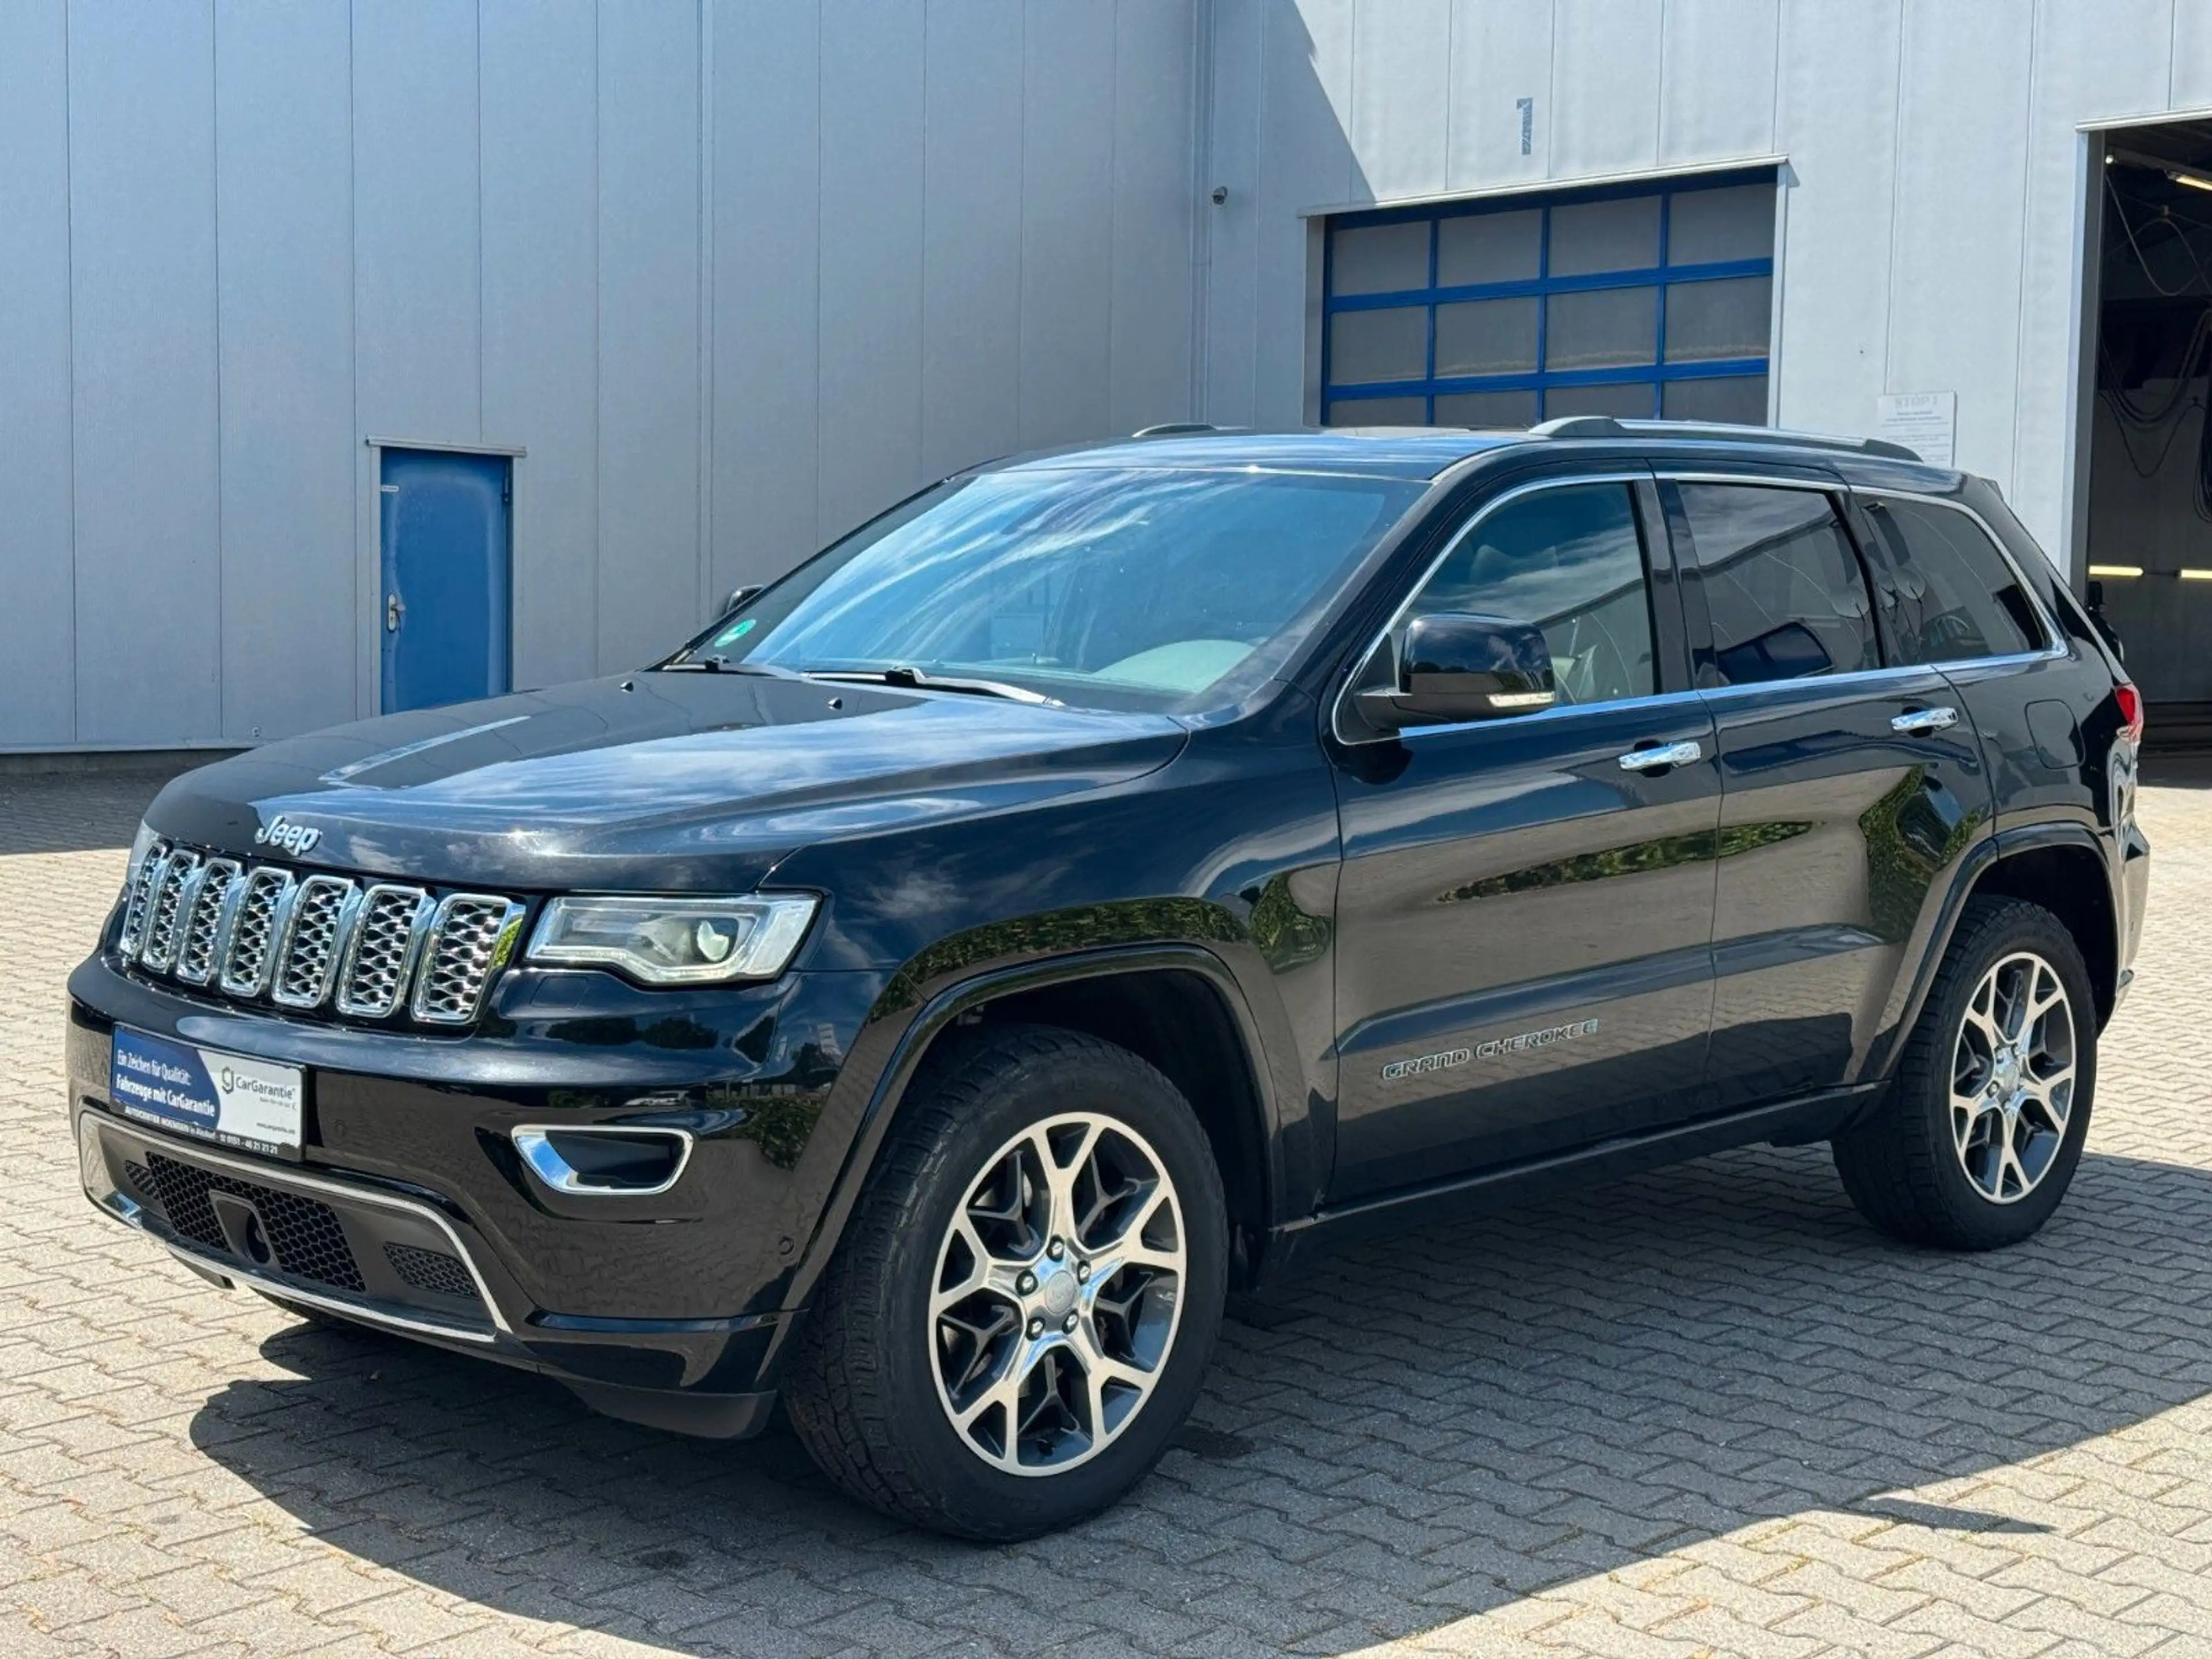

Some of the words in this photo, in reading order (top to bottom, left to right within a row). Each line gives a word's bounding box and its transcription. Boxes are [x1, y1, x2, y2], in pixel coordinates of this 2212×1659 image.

[1516, 97, 1533, 155] 1
[255, 816, 320, 857] Jeep
[118, 1049, 127, 1066] Ein
[127, 1052, 151, 1074] Zeichen
[151, 1059, 161, 1077] für
[1382, 1048, 1470, 1080] GRAND
[1475, 1018, 1598, 1059] CHEROKEE
[116, 1073, 153, 1103] Fahrzeuge
[153, 1087, 166, 1104] mit
[167, 1089, 215, 1117] CarGarantie
[269, 1145, 278, 1155] 21
